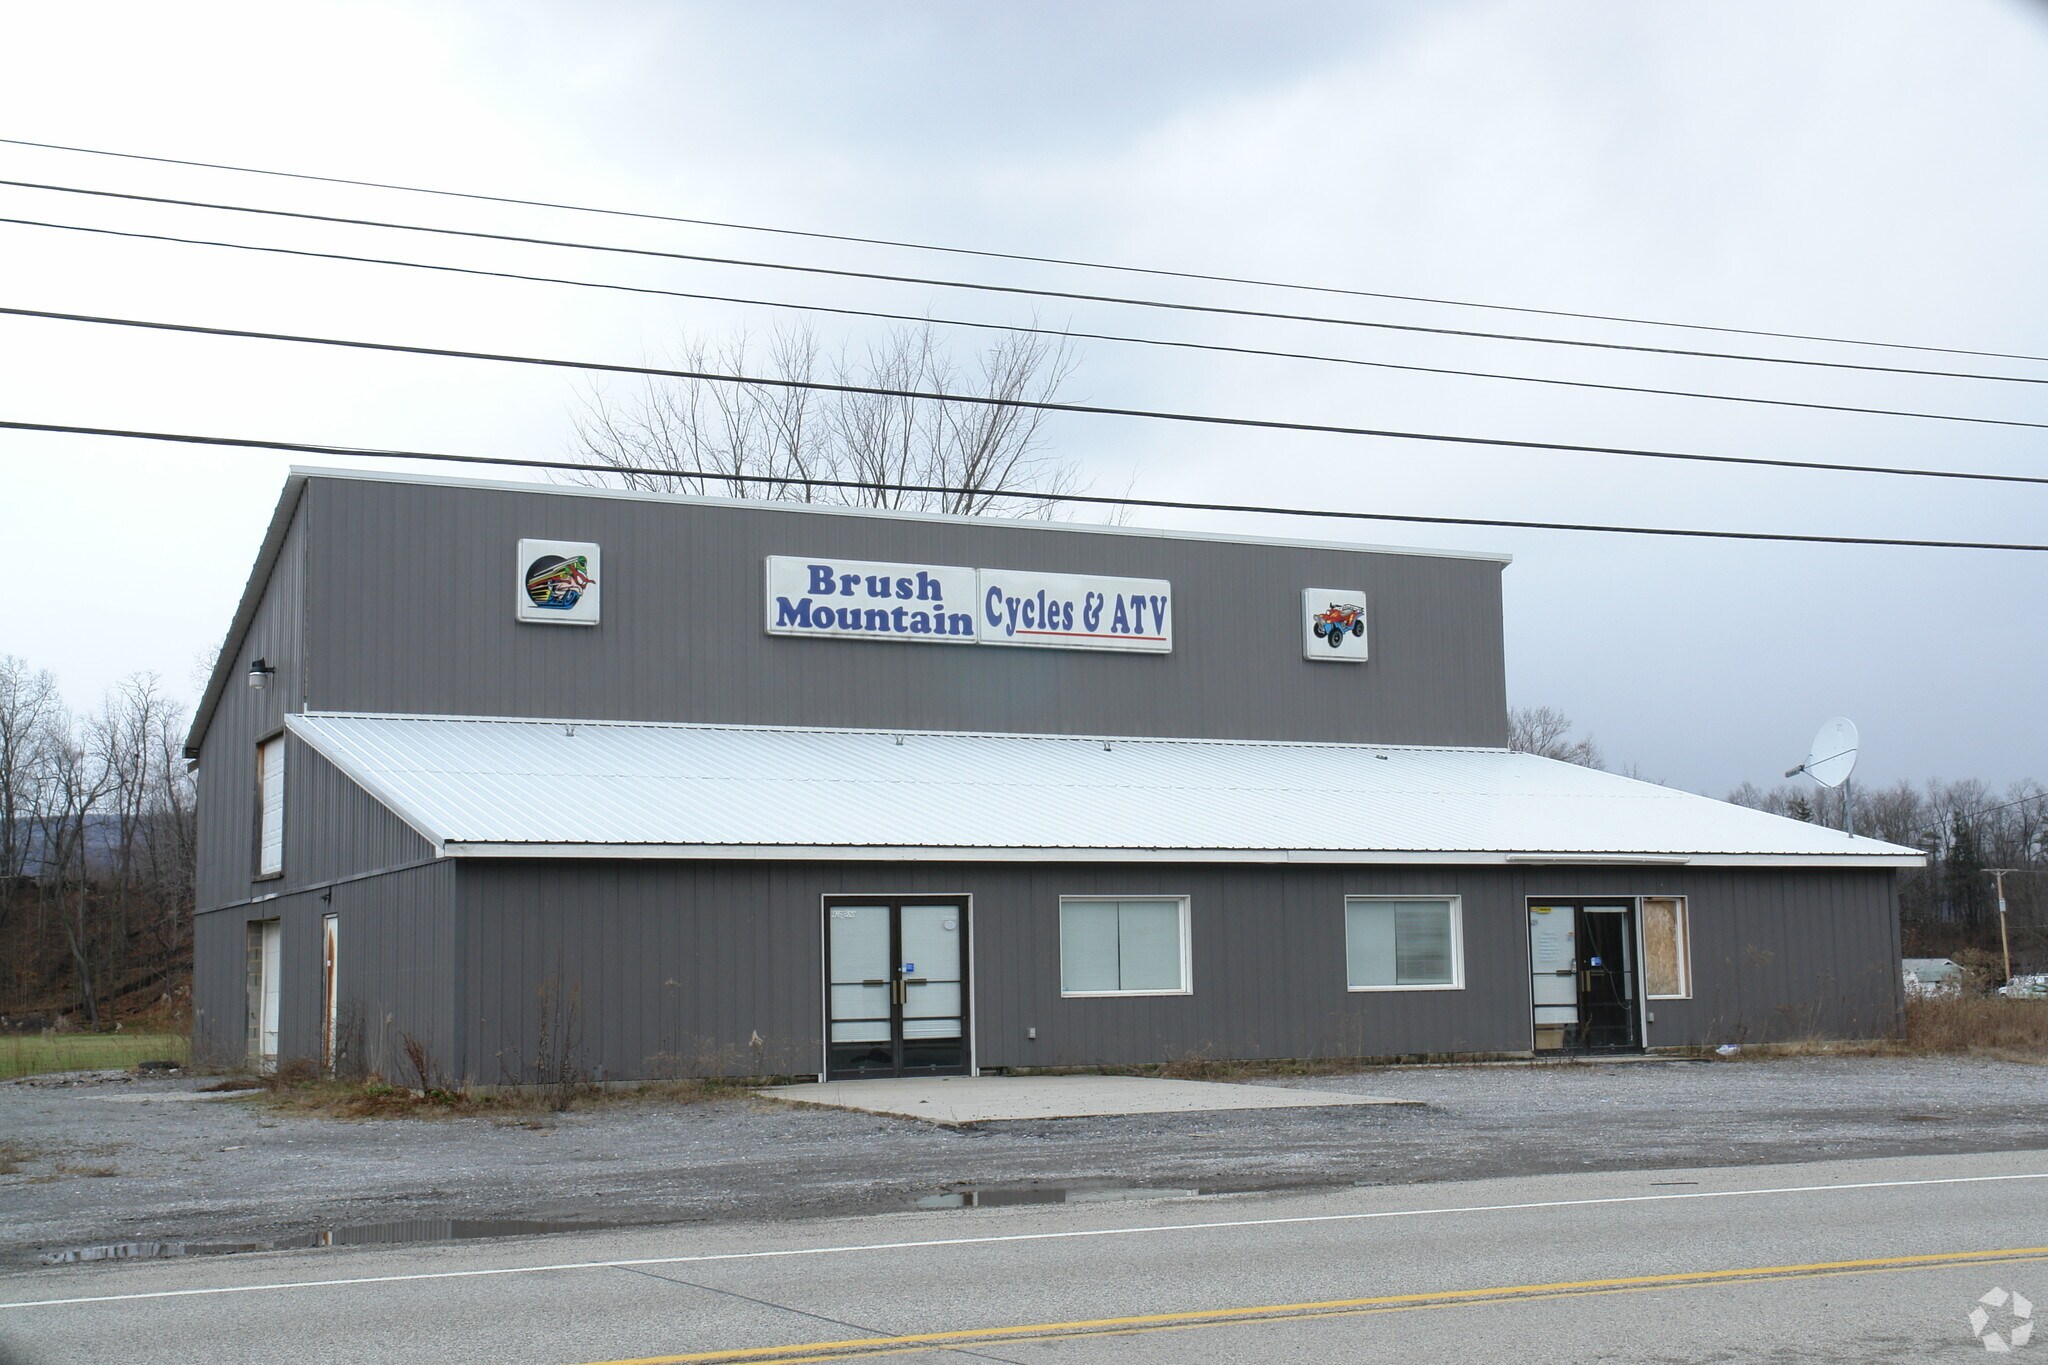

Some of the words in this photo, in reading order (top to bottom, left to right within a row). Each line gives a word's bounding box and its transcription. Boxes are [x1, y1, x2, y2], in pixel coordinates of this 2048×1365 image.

[807, 565, 943, 602] Brush
[776, 597, 975, 637] Mountain
[985, 586, 1074, 637] Cycles
[1083, 591, 1104, 633] &
[1111, 595, 1168, 636] ATV
